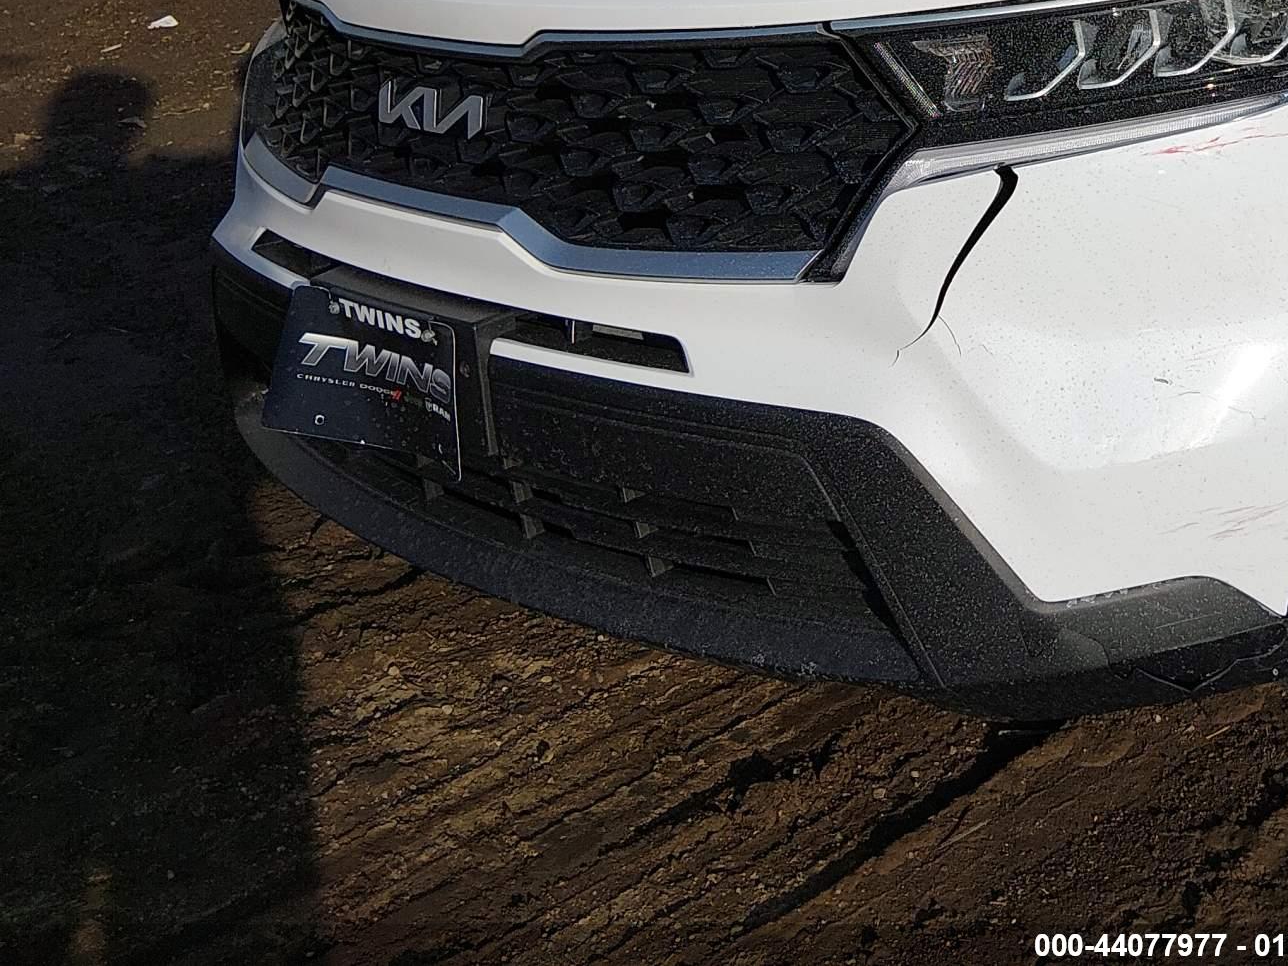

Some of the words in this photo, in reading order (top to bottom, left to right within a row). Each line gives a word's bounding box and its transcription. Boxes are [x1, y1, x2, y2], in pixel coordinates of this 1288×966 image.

[378, 80, 484, 140] KIA
[338, 297, 422, 340] TWINS
[296, 372, 355, 387] CHRYSLER
[298, 332, 452, 404] TWINS
